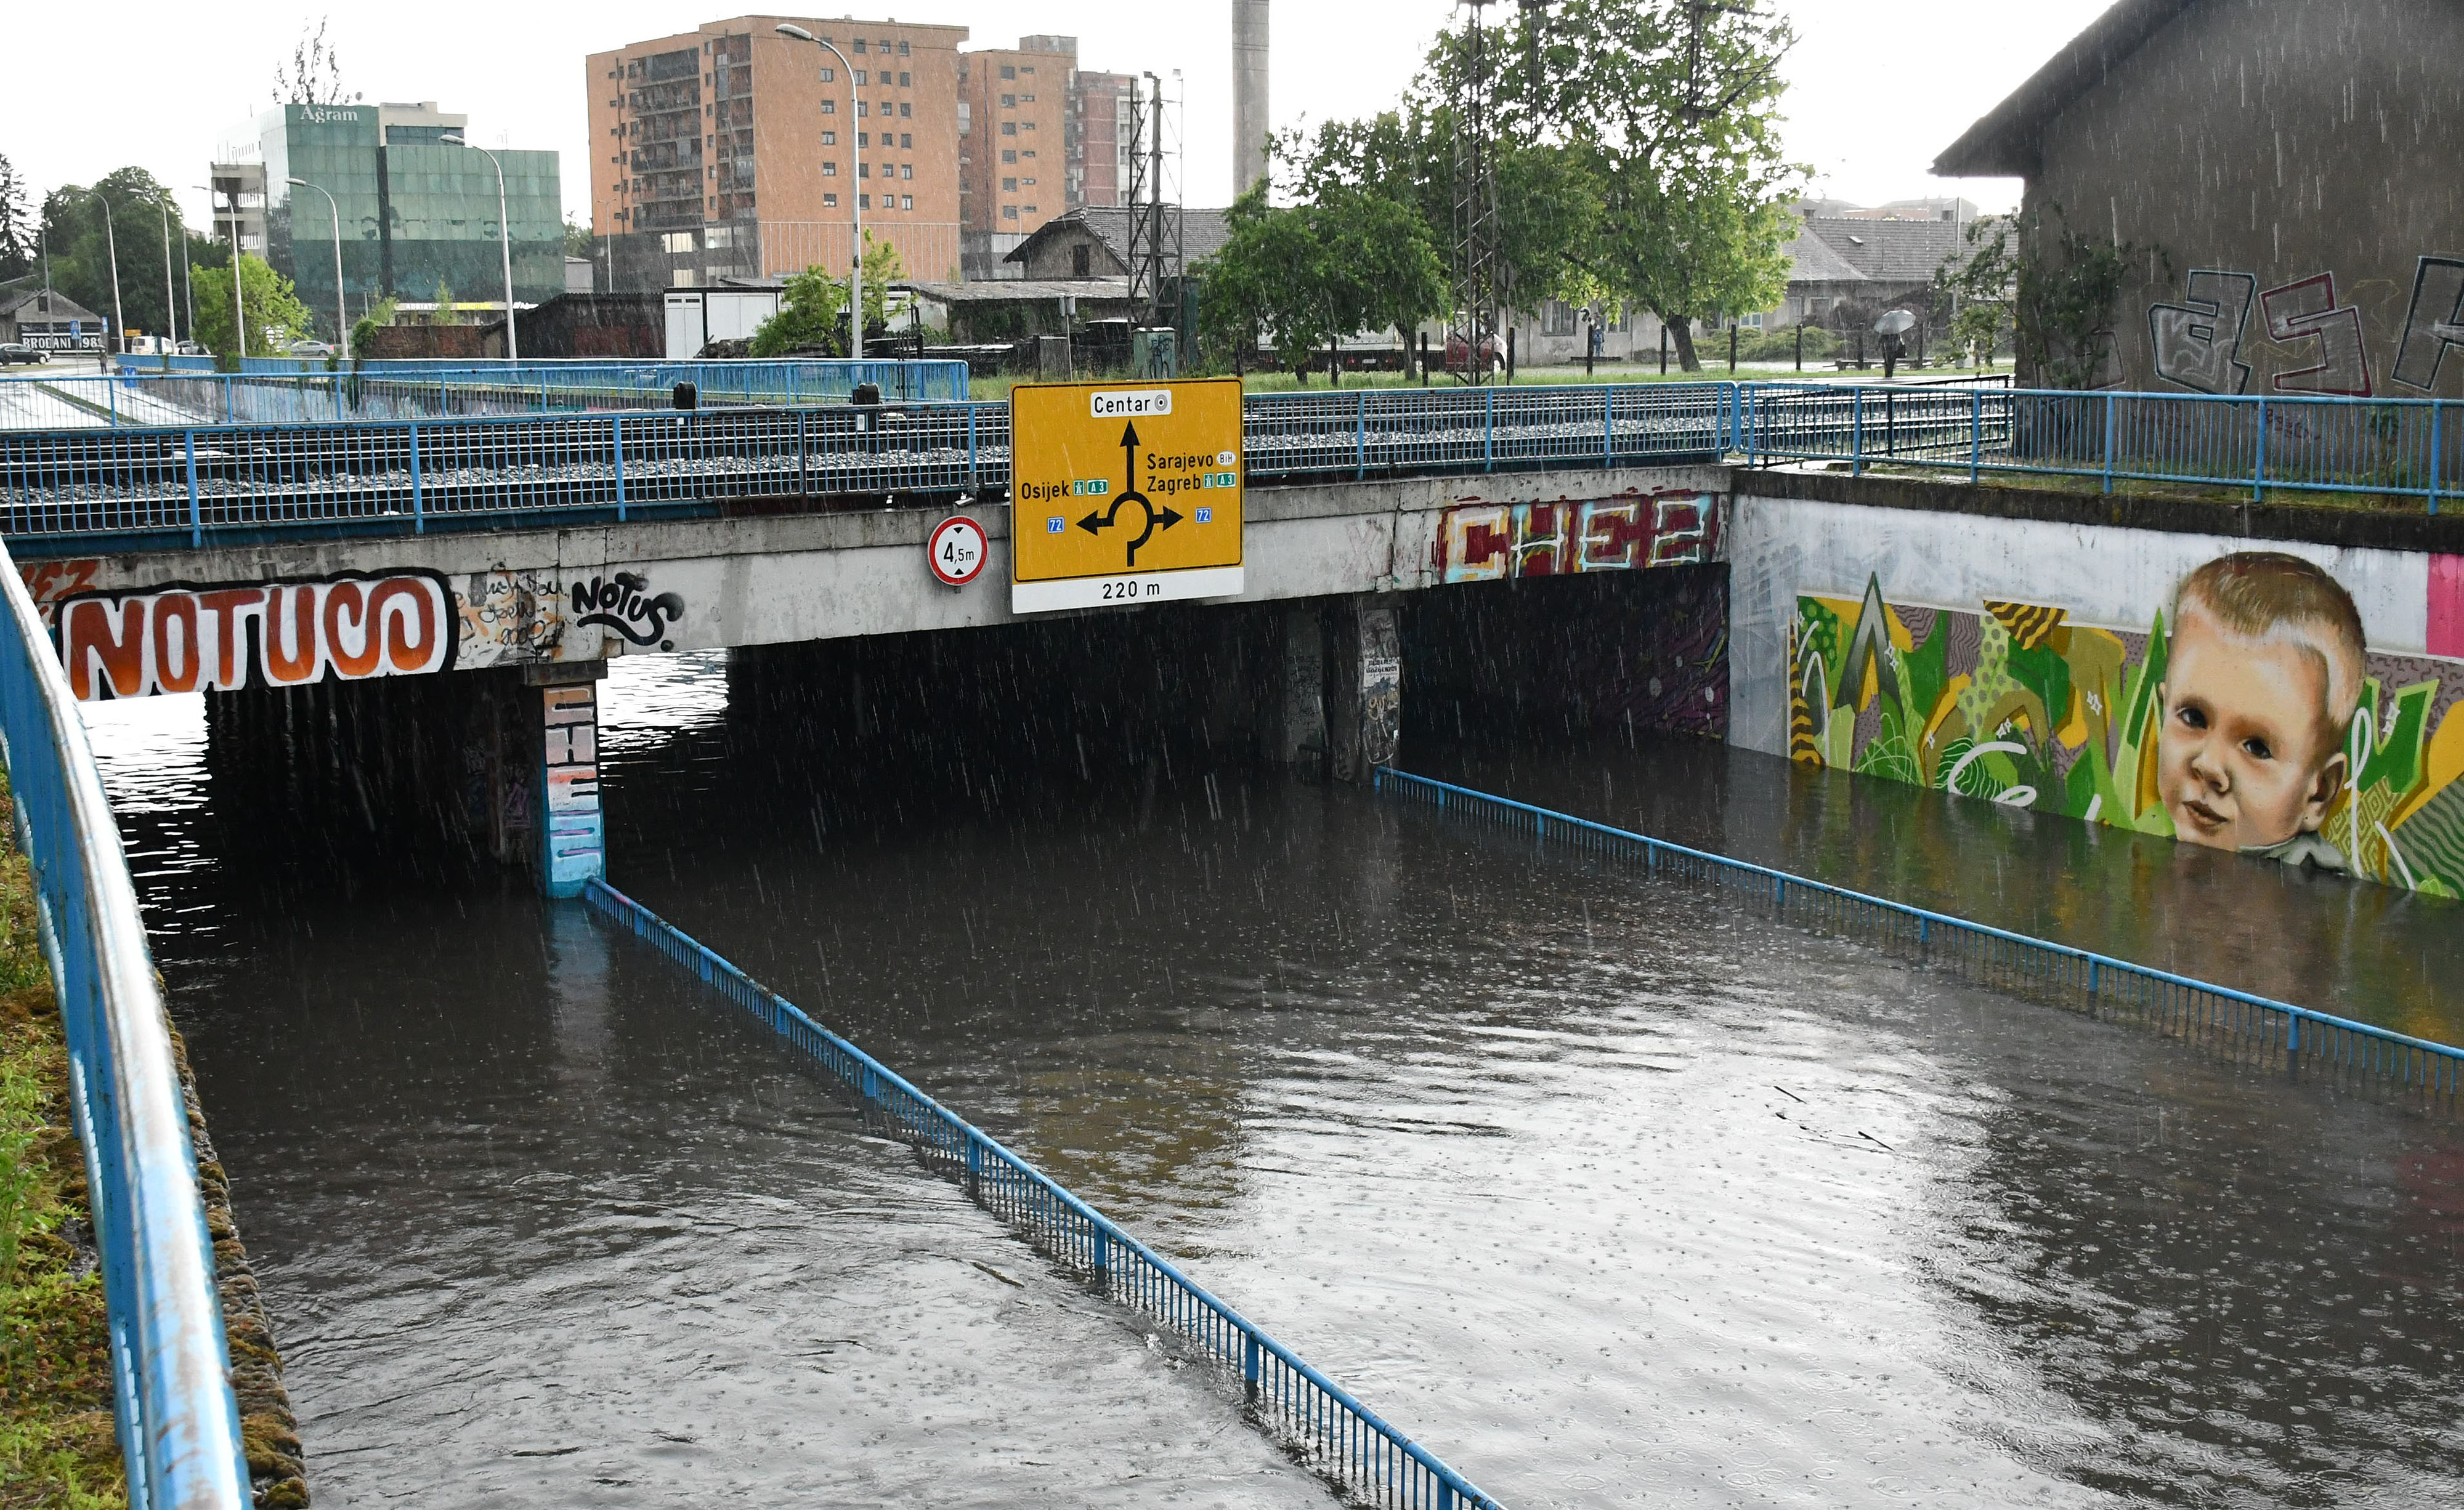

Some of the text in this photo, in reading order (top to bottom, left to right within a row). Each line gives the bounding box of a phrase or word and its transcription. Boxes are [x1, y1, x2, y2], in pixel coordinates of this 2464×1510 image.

[22, 337, 71, 349] BRODANI
[1094, 396, 1151, 414] Centar
[1147, 453, 1233, 472] Sarajevo BiH
[1021, 480, 1069, 502] Osijek
[1147, 474, 1201, 495] Zagreb
[1197, 509, 1210, 522] 72
[1049, 519, 1063, 531] 72
[1102, 581, 1161, 600] 220 m
